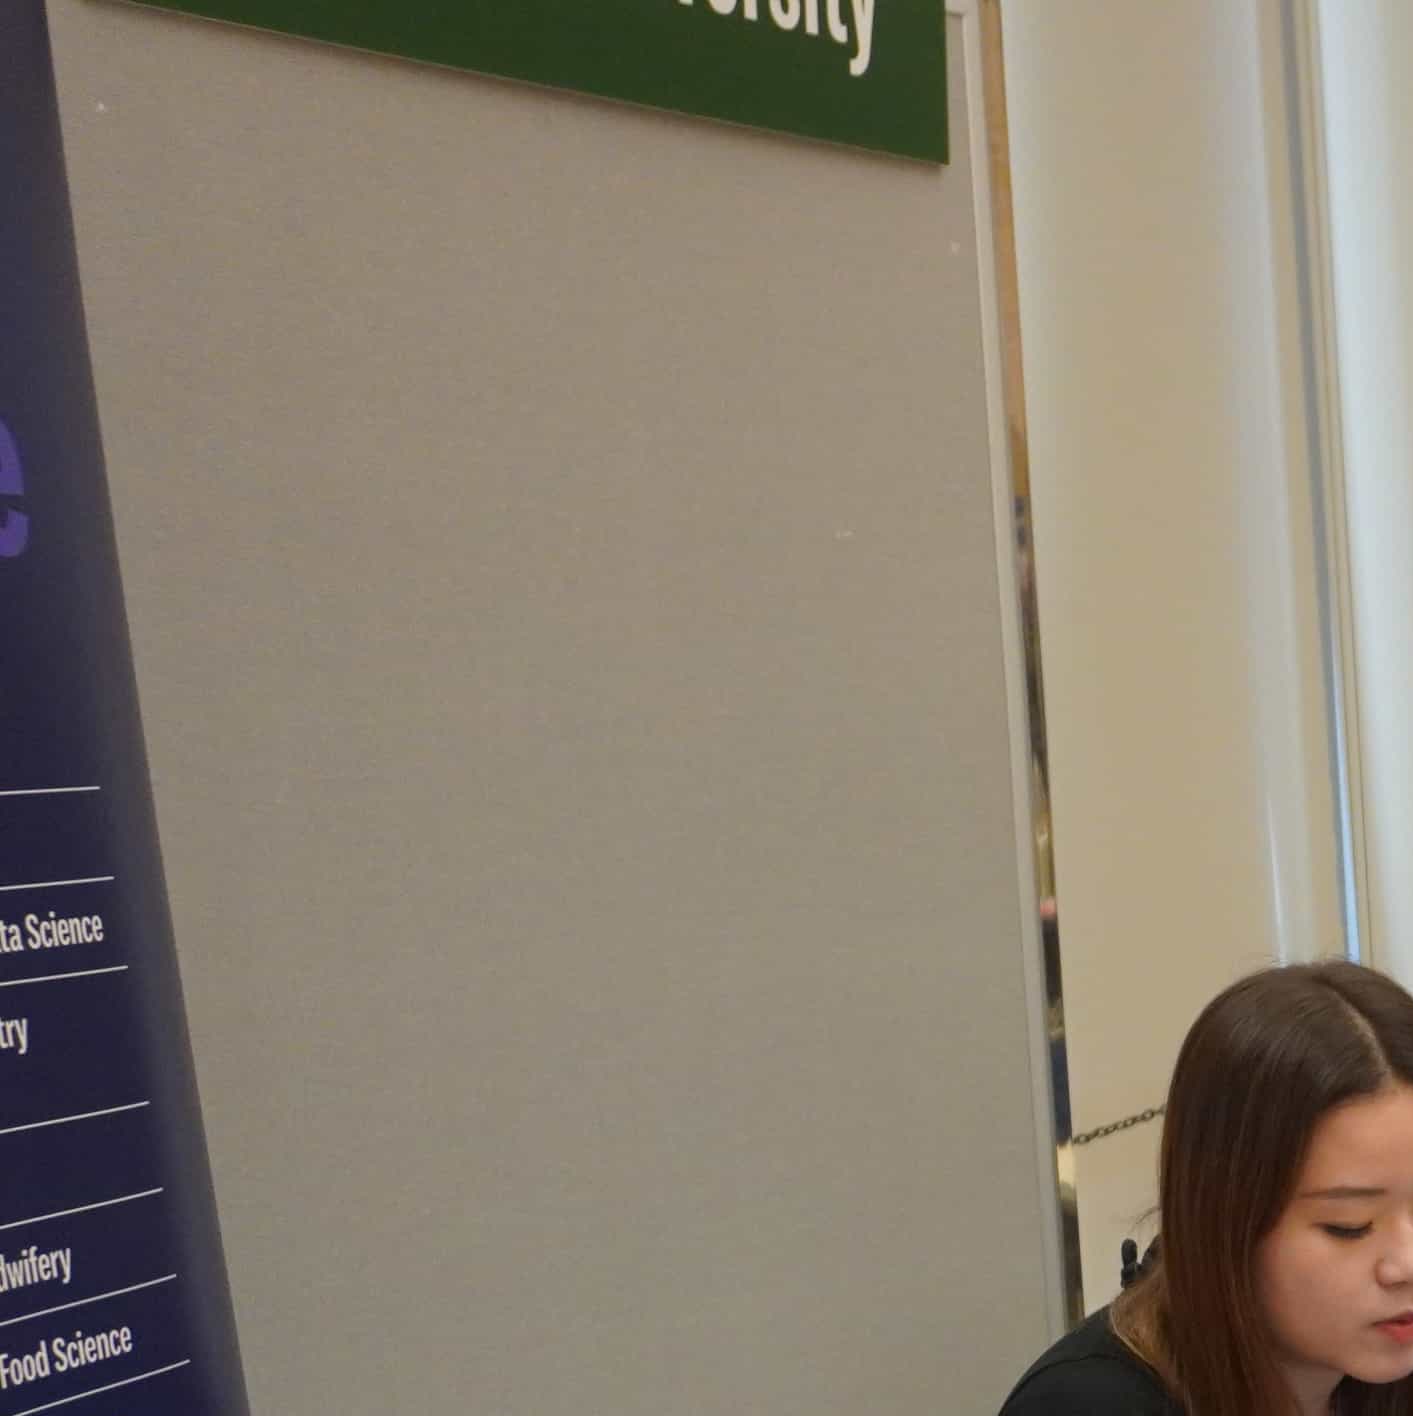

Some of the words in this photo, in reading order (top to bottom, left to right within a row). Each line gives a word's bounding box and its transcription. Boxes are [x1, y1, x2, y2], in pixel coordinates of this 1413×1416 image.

[0, 918, 24, 953] ta
[25, 911, 104, 950] Science
[0, 1017, 28, 1055] try
[0, 1246, 71, 1293] dwifery
[0, 1340, 51, 1390] Food
[52, 1326, 133, 1373] Science
